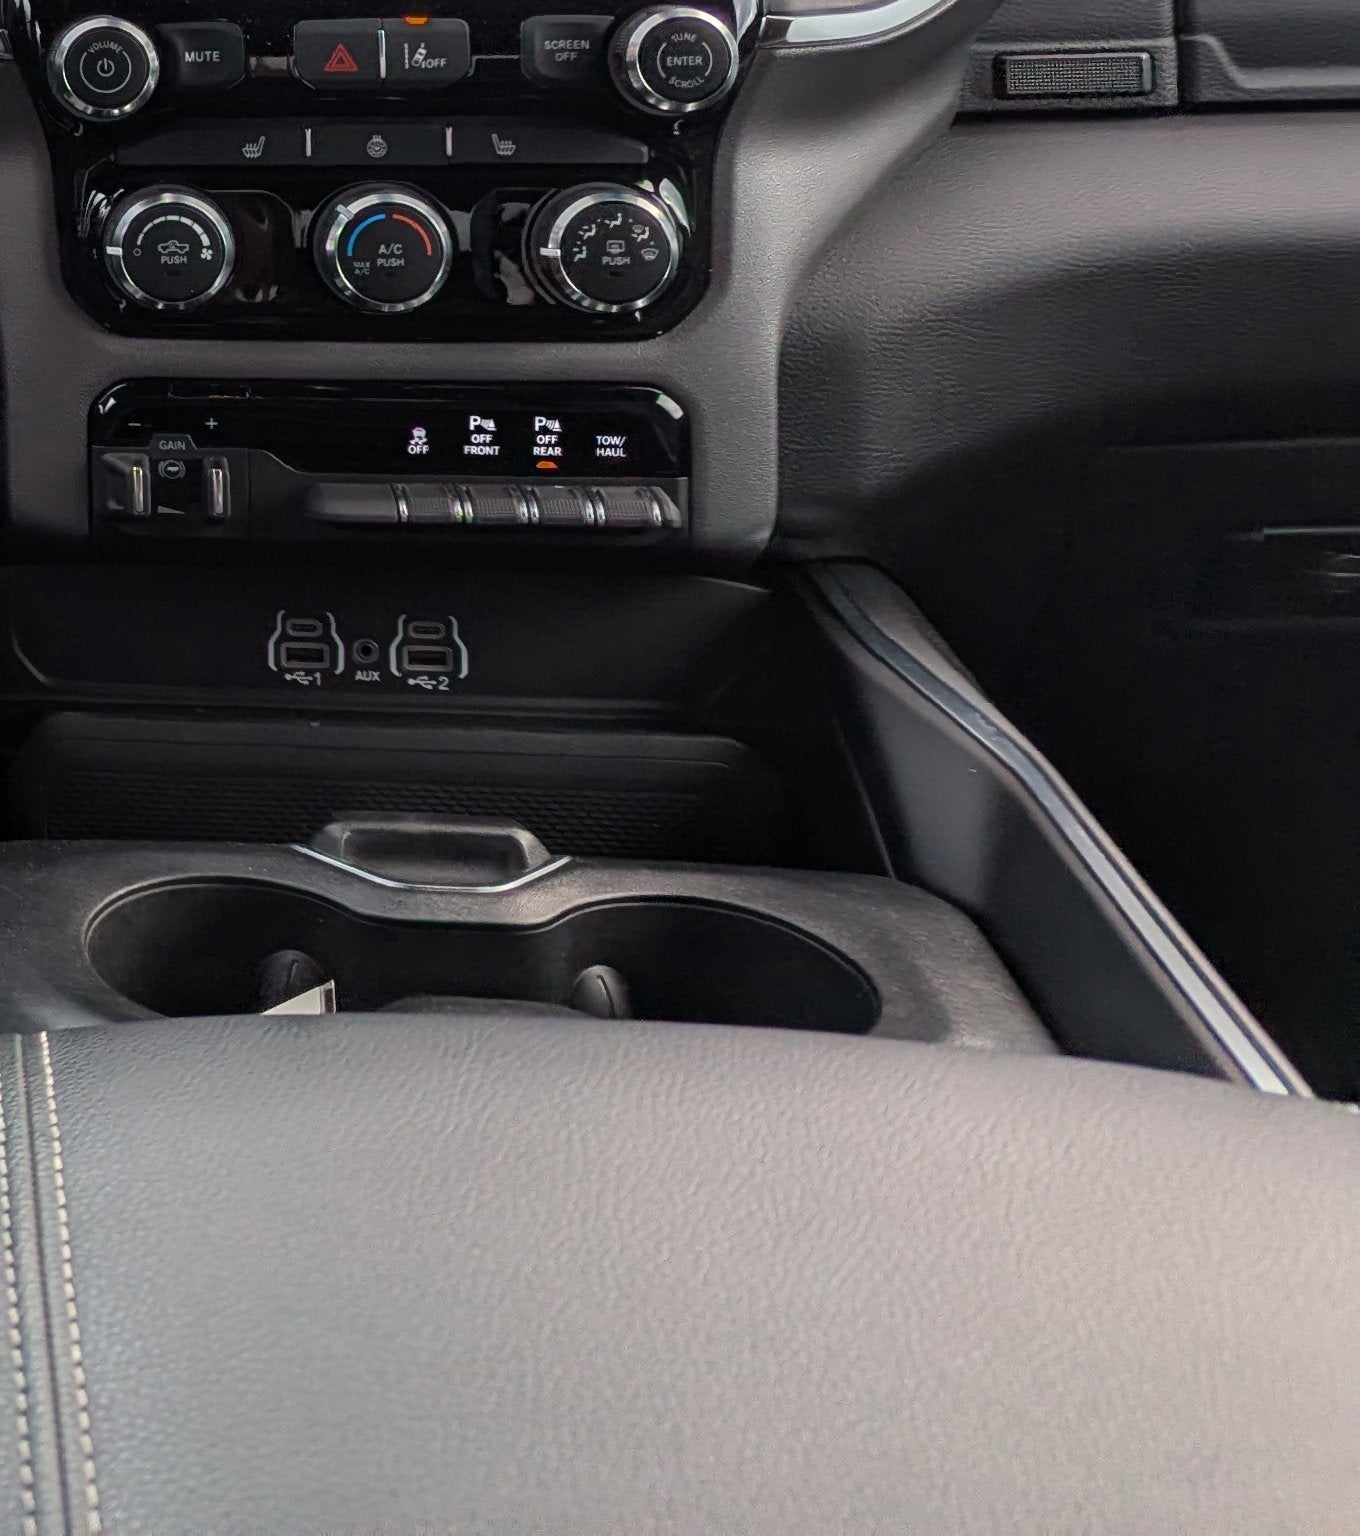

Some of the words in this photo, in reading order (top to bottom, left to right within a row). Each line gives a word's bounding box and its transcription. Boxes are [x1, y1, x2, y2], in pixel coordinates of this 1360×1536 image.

[671, 32, 697, 43] TUNE
[87, 40, 123, 55] VOLUME
[544, 39, 590, 50] SCREEN
[184, 51, 221, 63] MUTE
[555, 51, 578, 62] OFF
[666, 55, 703, 67] ENTER
[425, 58, 447, 69] OFF
[668, 76, 706, 88] SCROLL
[378, 242, 403, 255] A/C
[160, 255, 188, 264] PUSH
[376, 257, 405, 267] PUSH
[602, 256, 631, 266] PUSH
[470, 434, 493, 444] OFF
[536, 434, 559, 445] OFF
[596, 435, 626, 446] TOW/
[159, 440, 186, 451] GAIN
[407, 444, 429, 455] OFF
[463, 445, 500, 456] FRONT
[533, 446, 563, 456] REAR
[596, 447, 628, 458] HAUL
[354, 670, 381, 682] AUX
